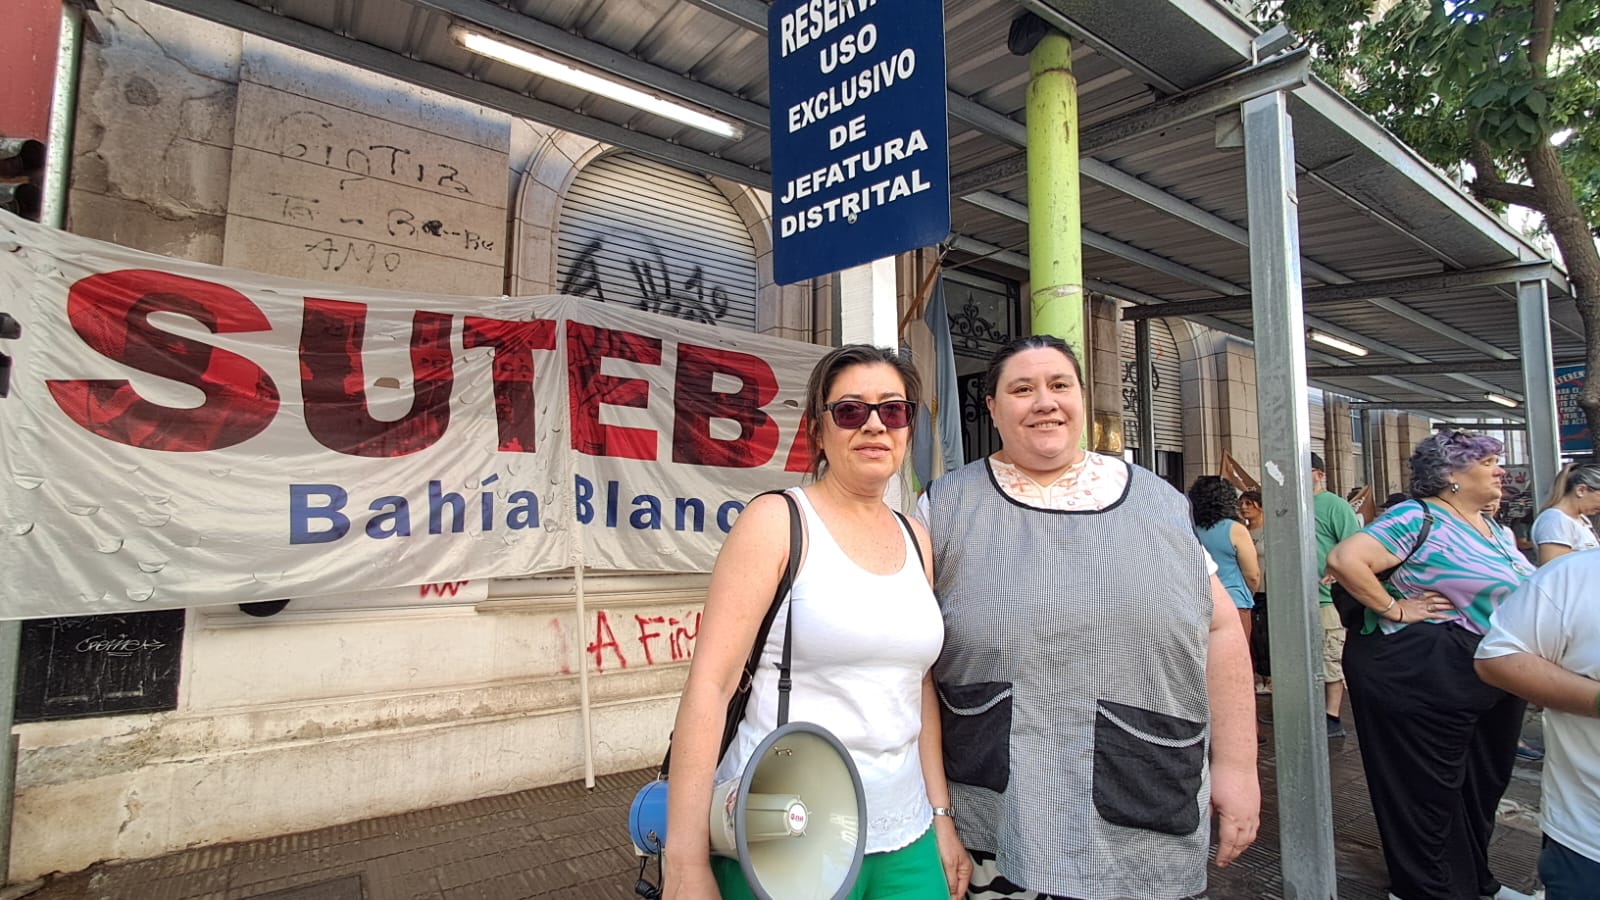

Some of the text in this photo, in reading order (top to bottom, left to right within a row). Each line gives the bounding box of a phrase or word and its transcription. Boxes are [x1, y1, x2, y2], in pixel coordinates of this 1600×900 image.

[781, 0, 877, 58] RESER
[819, 23, 878, 74] USO
[788, 48, 916, 133] EXCLUSIVO
[780, 129, 928, 204] JEFATURA
[829, 115, 867, 150] DE
[780, 168, 931, 238] DISTRITAL
[289, 473, 540, 545] Bahía
